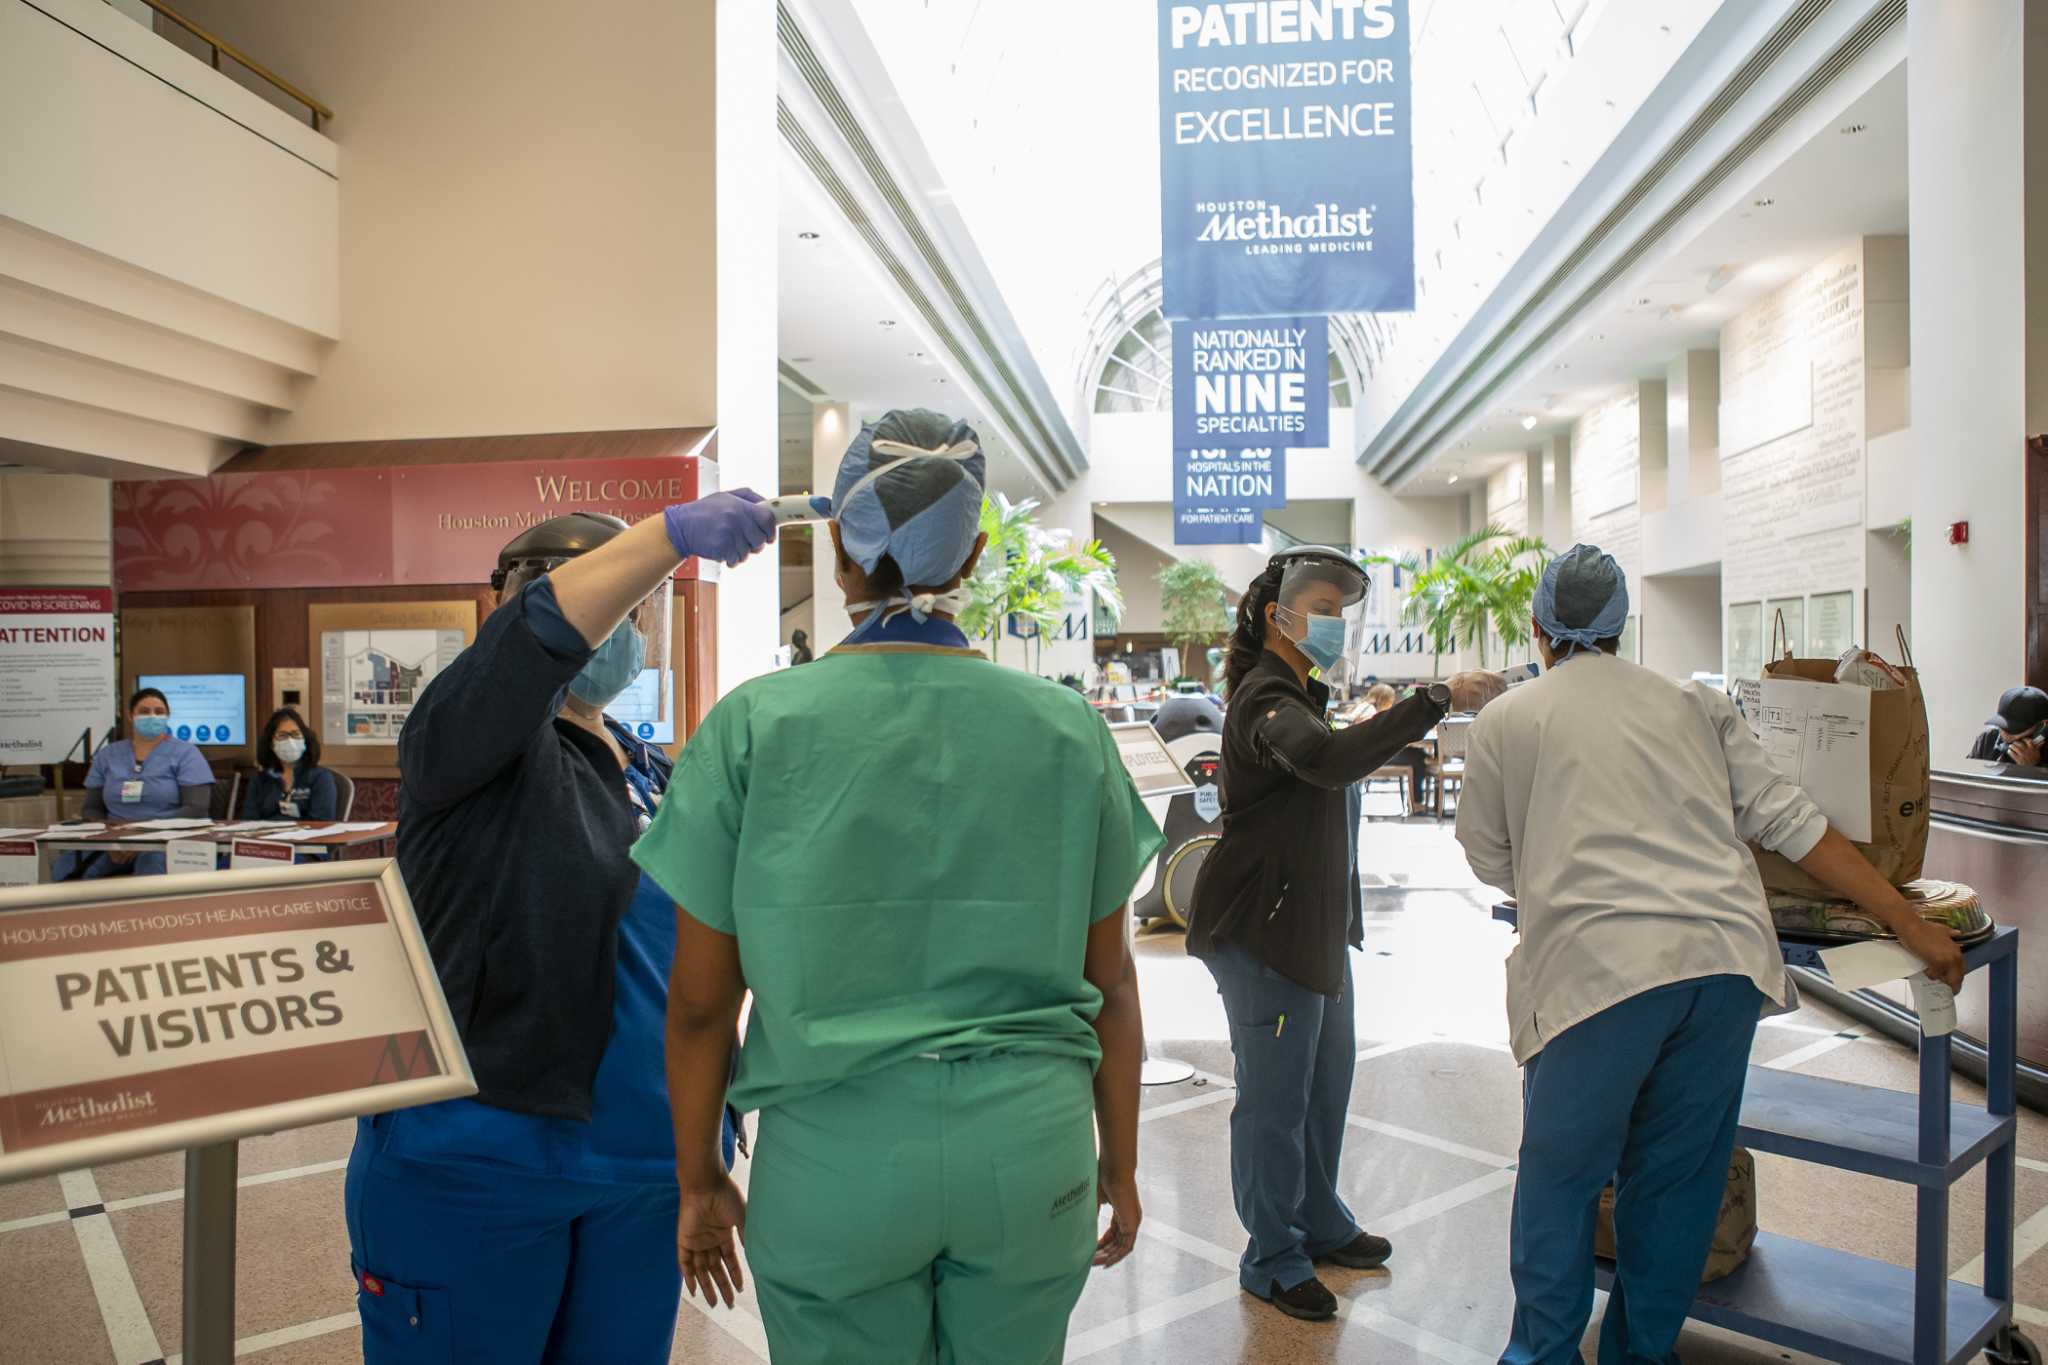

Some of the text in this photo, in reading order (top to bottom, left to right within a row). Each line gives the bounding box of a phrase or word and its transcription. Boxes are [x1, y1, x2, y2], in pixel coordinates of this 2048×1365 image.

[1171, 0, 1395, 48] PATIENTS
[1174, 58, 1394, 93] RECOGNIZED FOR
[1175, 102, 1395, 144] EXCELLENCE
[1197, 200, 1266, 212] HOUSTON
[1197, 203, 1374, 242] Methodist
[1246, 241, 1373, 255] LEADING MEDICINE
[1193, 329, 1306, 349] NATIONALLY
[1193, 348, 1306, 372] RANKED IN
[1195, 373, 1306, 414] NINE
[1197, 416, 1305, 434] SPECIALTIES
[1187, 461, 1272, 472] HOSPITALS IN THE
[534, 473, 683, 503] WELCOME
[1186, 474, 1272, 497] NATION
[438, 512, 510, 530] Houston
[43, 600, 101, 610] SCREENING
[0, 627, 105, 643] ATTENTION
[1, 897, 371, 945] HOUSTON METHODIST HEALTH CARE NOTICE
[55, 940, 354, 1012] PATIENTS &
[98, 990, 344, 1058] VISITORS
[41, 1091, 156, 1128] Methodist
